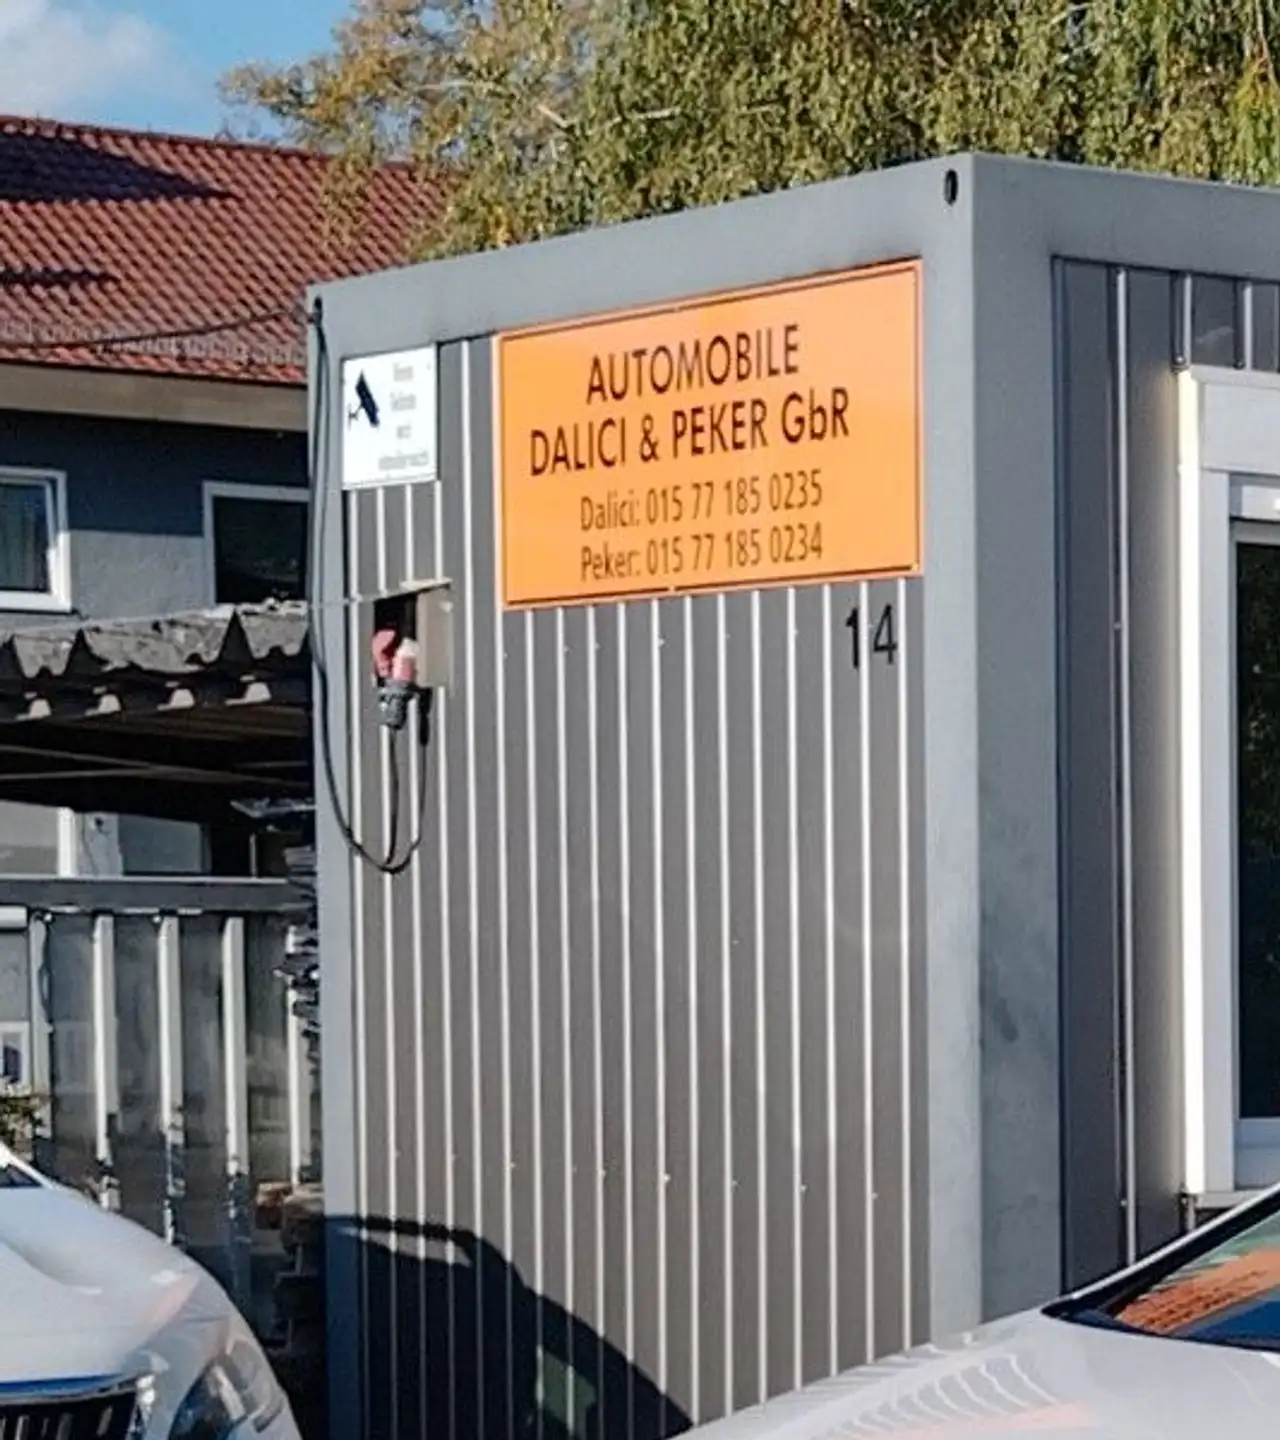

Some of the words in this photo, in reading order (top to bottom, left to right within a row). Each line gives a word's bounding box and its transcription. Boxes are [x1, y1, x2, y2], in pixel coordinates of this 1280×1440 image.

[586, 325, 799, 404] AUTOMOBILE
[530, 418, 627, 476] DALICI
[639, 414, 660, 463] &
[673, 397, 768, 458] PEKER
[781, 387, 850, 444] GbR
[580, 493, 640, 531] Dalici:
[646, 485, 683, 525] 015
[691, 481, 715, 519] 77
[724, 476, 760, 515] 185
[769, 469, 824, 510] 0235
[580, 543, 641, 581] Peker:
[646, 536, 683, 575] 015
[691, 534, 715, 570] 77
[724, 528, 760, 567] 185
[769, 522, 824, 563] 0234
[846, 604, 898, 670] 14
